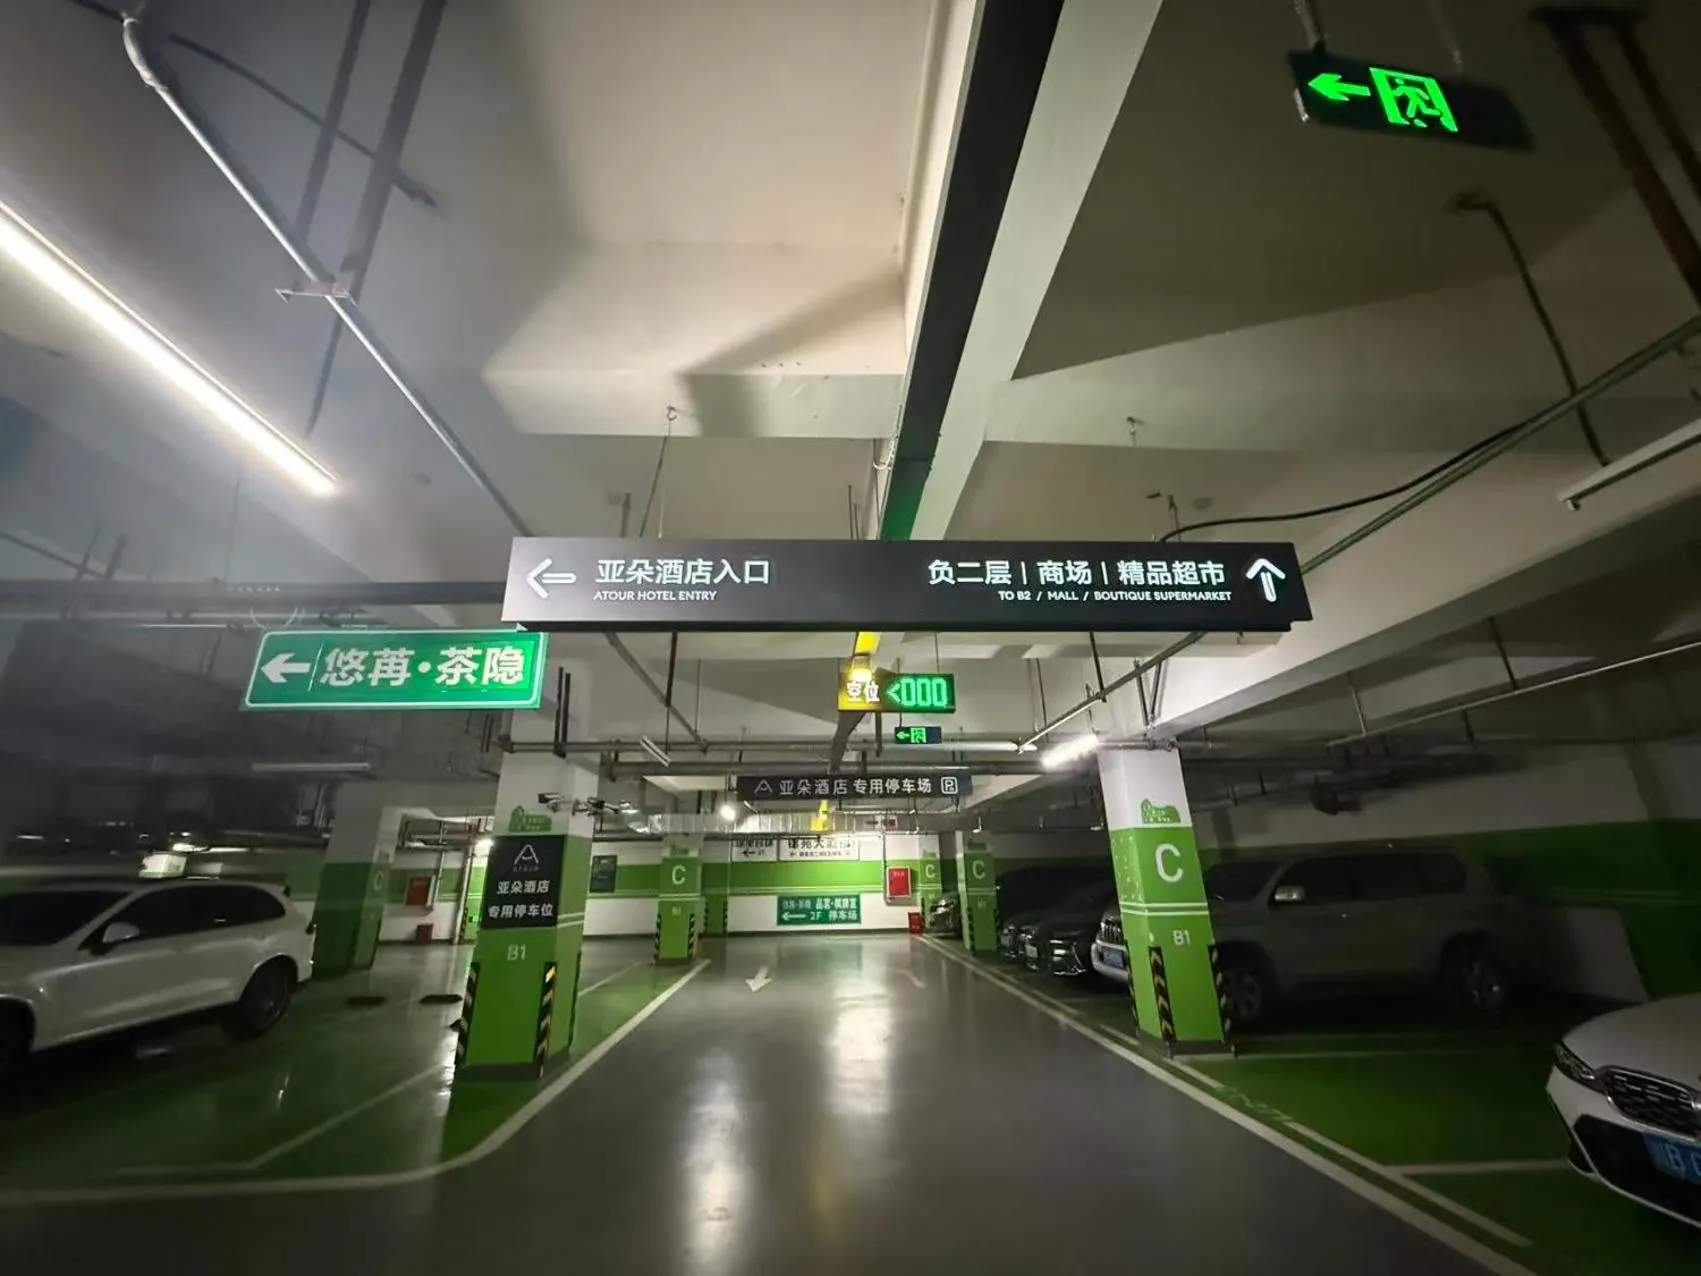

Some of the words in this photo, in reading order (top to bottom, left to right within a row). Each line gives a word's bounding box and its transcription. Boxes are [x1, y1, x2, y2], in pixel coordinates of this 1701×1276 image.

[595, 558, 770, 585] 亚朵酒店入口
[928, 559, 1012, 586] 负二层
[1037, 560, 1092, 586] 商场
[1117, 559, 1225, 586] 精品超市
[594, 590, 635, 601] ATOUR
[637, 590, 676, 601] HOTEL
[678, 590, 717, 601] ENTRY
[998, 590, 1015, 601] TO
[1016, 590, 1032, 601] B2
[1047, 590, 1079, 601] MALL
[1094, 591, 1151, 602] BOUTIQUE
[1153, 591, 1232, 602] SUPERMARKET
[779, 779, 848, 795] 亚朵酒店
[853, 778, 932, 794] 专用停车场
[925, 864, 936, 878] C
[972, 860, 986, 880] C
[1155, 843, 1184, 883] C
[671, 864, 687, 885] C
[496, 879, 551, 895] 亚朵酒店
[488, 903, 554, 919] 专用停车位
[828, 910, 858, 921] 停车场
[1172, 929, 1191, 946] B1
[507, 944, 526, 961] B1
